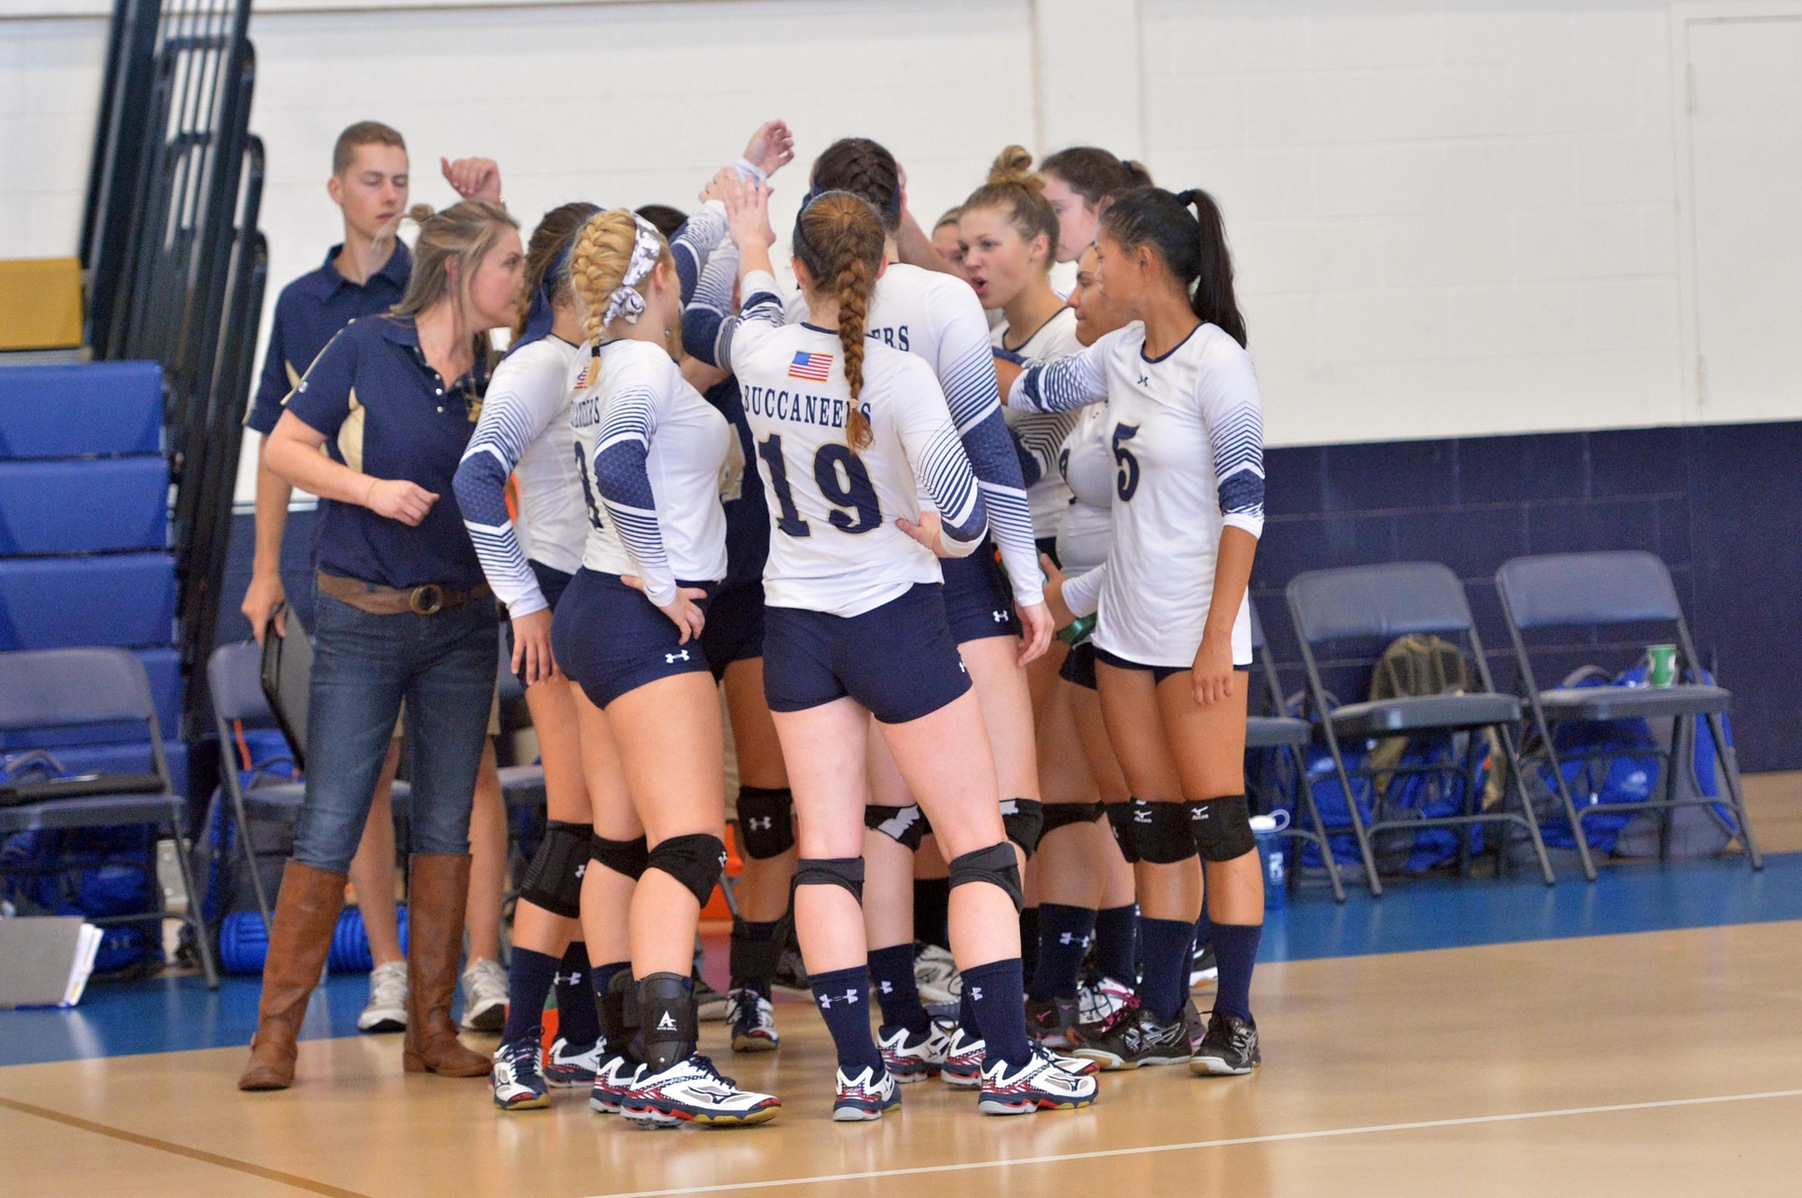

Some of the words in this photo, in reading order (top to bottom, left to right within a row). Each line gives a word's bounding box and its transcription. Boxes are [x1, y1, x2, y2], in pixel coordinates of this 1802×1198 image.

[744, 384, 872, 430] BUCCANEES
[757, 431, 883, 537] 19
[1112, 421, 1141, 502] 5
